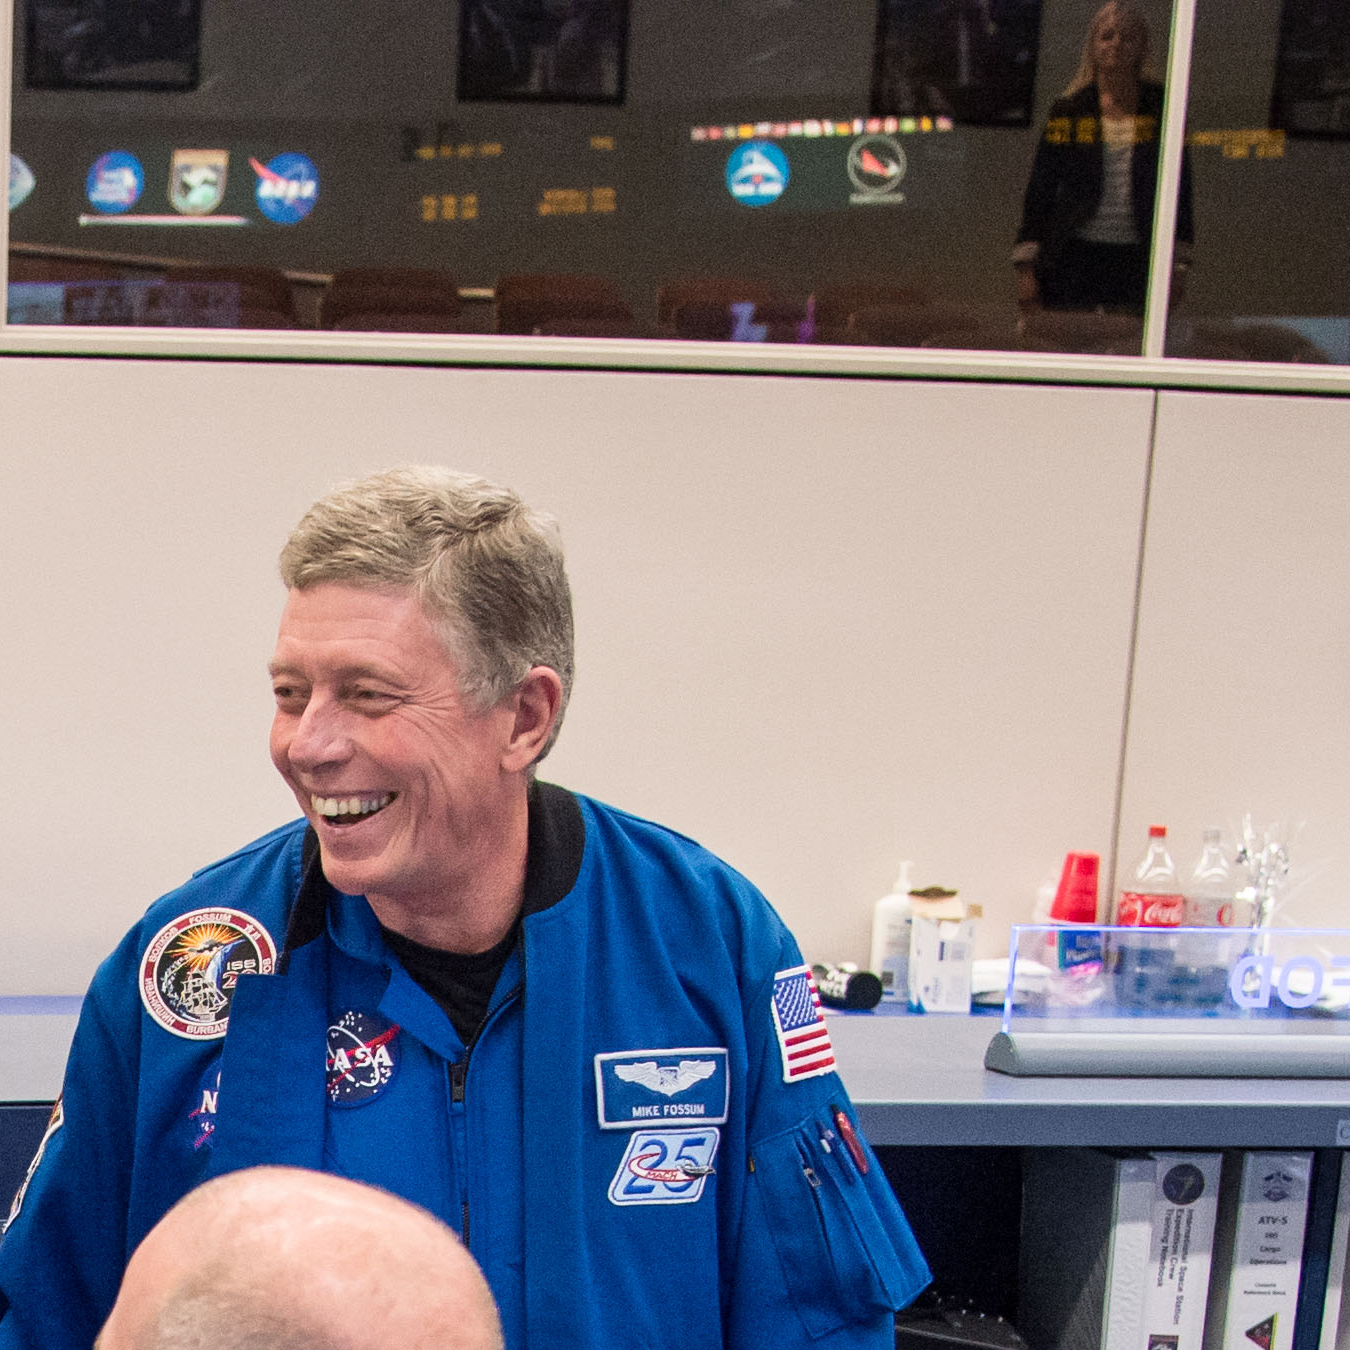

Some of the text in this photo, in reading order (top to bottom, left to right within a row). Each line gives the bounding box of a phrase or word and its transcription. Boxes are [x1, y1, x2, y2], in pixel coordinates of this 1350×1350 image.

[188, 912, 232, 925] FOSSUM
[226, 958, 257, 971] ISS
[186, 1020, 228, 1035] BURBAN
[632, 1103, 705, 1118] MIKE FOSSUM
[622, 1137, 707, 1195] 25
[1157, 1208, 1175, 1288] Training Notebook
[1168, 1208, 1185, 1280] Expedition Crew
[1173, 1208, 1194, 1325] International Space Station
